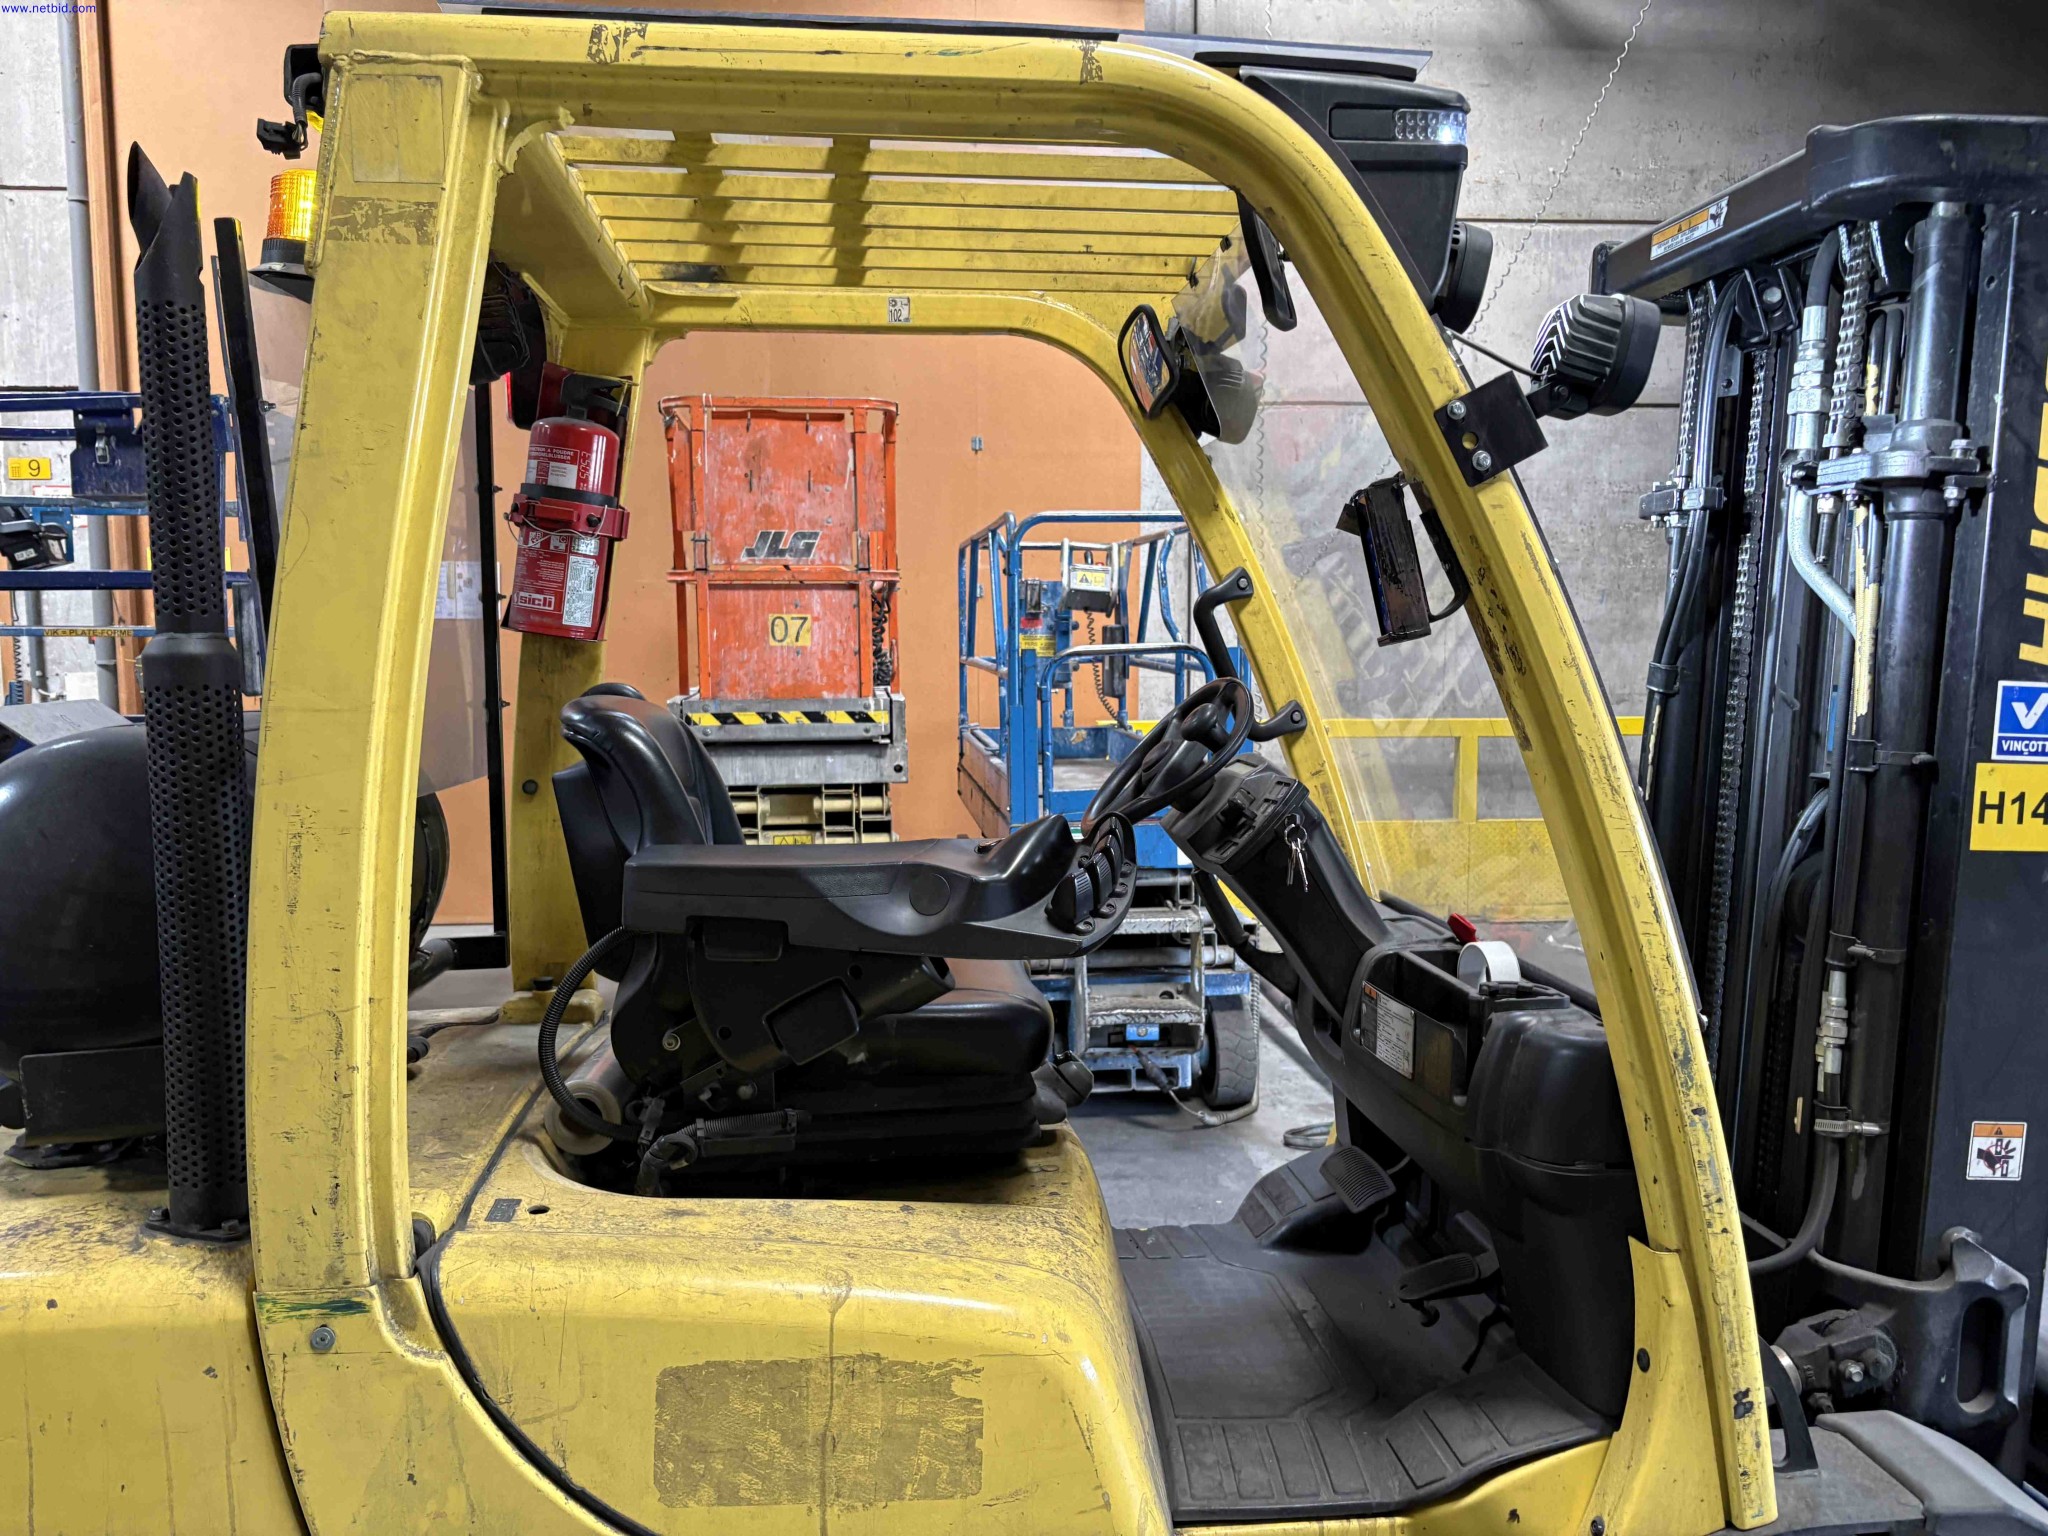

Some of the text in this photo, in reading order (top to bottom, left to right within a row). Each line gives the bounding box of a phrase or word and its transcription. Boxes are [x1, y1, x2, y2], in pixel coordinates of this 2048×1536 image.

[28, 459, 40, 477] 9
[741, 530, 822, 559] JLG
[519, 594, 553, 609] sicli
[770, 615, 808, 643] 07
